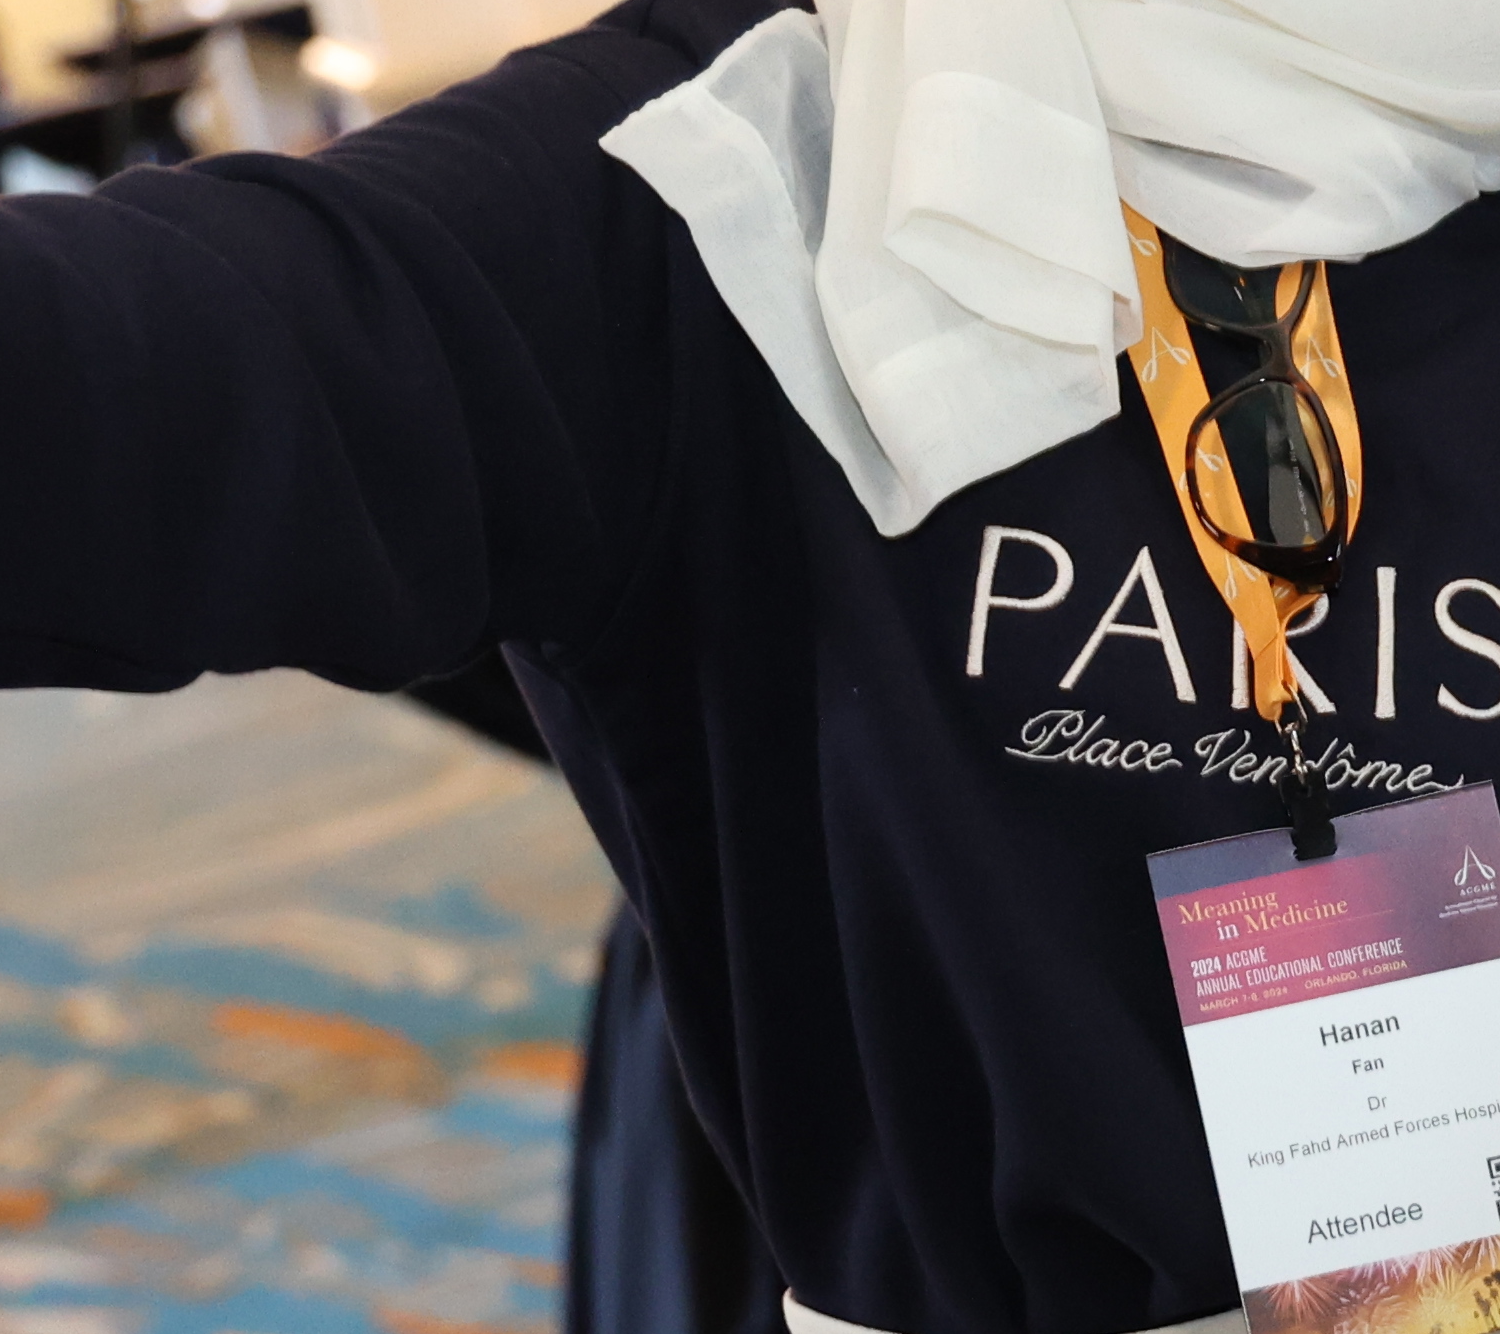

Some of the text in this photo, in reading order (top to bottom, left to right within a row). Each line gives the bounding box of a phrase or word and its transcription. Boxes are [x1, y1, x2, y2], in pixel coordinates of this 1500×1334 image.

[1004, 709, 1183, 774] Place
[1177, 890, 1279, 925] Meaning
[1216, 899, 1349, 941] in Medicine
[1190, 945, 1268, 978] 2024 ACGME
[1196, 937, 1404, 998] ANNUAL EDUCATIONAL CONFERENCE
[1199, 996, 1239, 1012] MARCH
[1362, 959, 1408, 977] FLORIDA
[1319, 1015, 1401, 1047] Hanan
[1351, 1056, 1385, 1075] Fan
[1367, 1095, 1388, 1111] Dr
[1247, 1148, 1285, 1168] King
[1289, 1137, 1332, 1160] Fahd
[1337, 1124, 1390, 1149] Armed
[1394, 1113, 1450, 1137] Forces
[1307, 1202, 1425, 1245] Attendee
